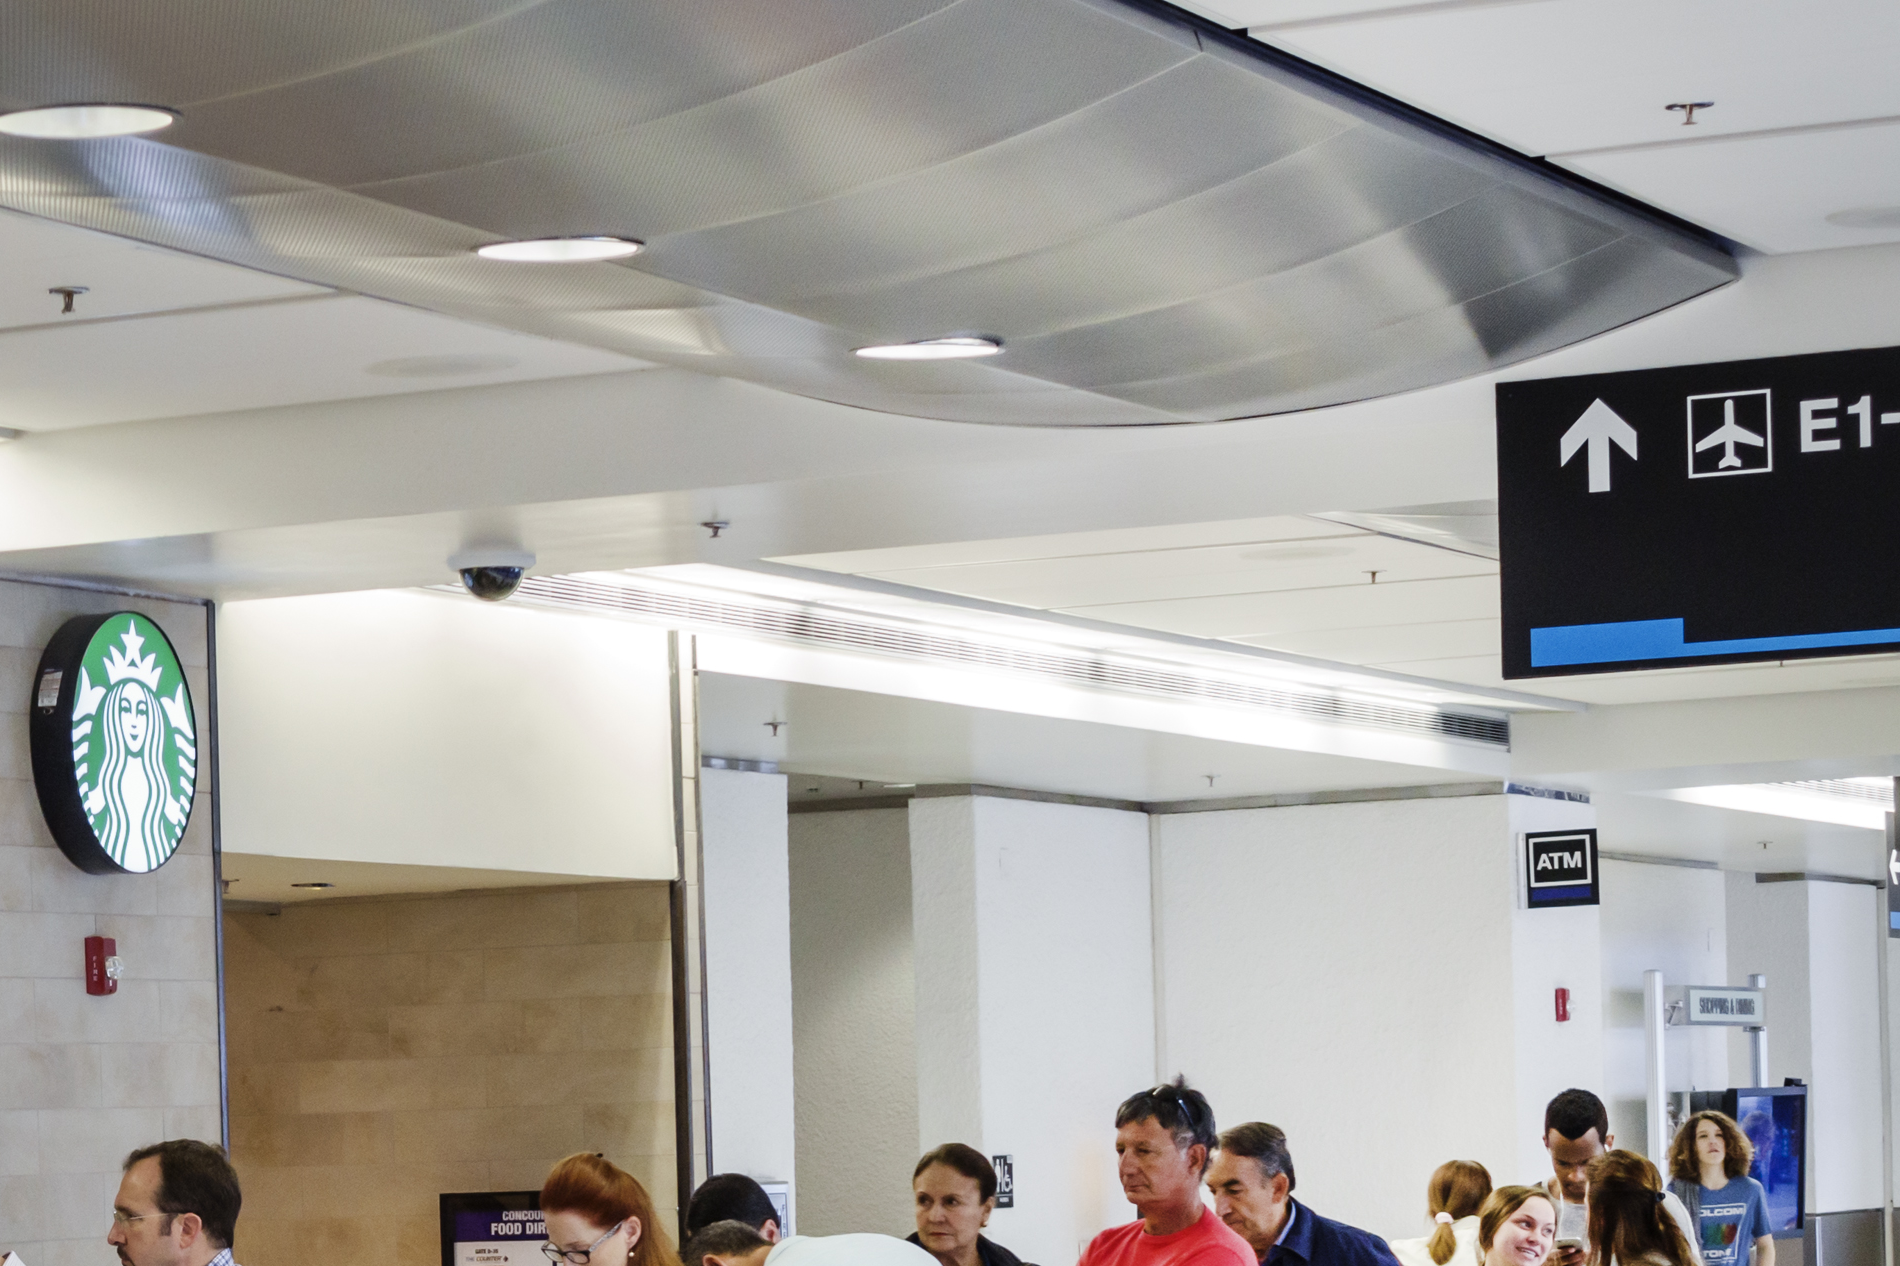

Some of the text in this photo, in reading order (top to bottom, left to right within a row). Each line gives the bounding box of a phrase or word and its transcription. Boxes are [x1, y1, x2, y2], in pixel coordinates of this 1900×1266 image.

[1536, 850, 1583, 871] ATM
[1700, 1207, 1744, 1217] OLCOM
[490, 1221, 549, 1236] FOOD DIR
[1703, 1248, 1732, 1258] TONE
